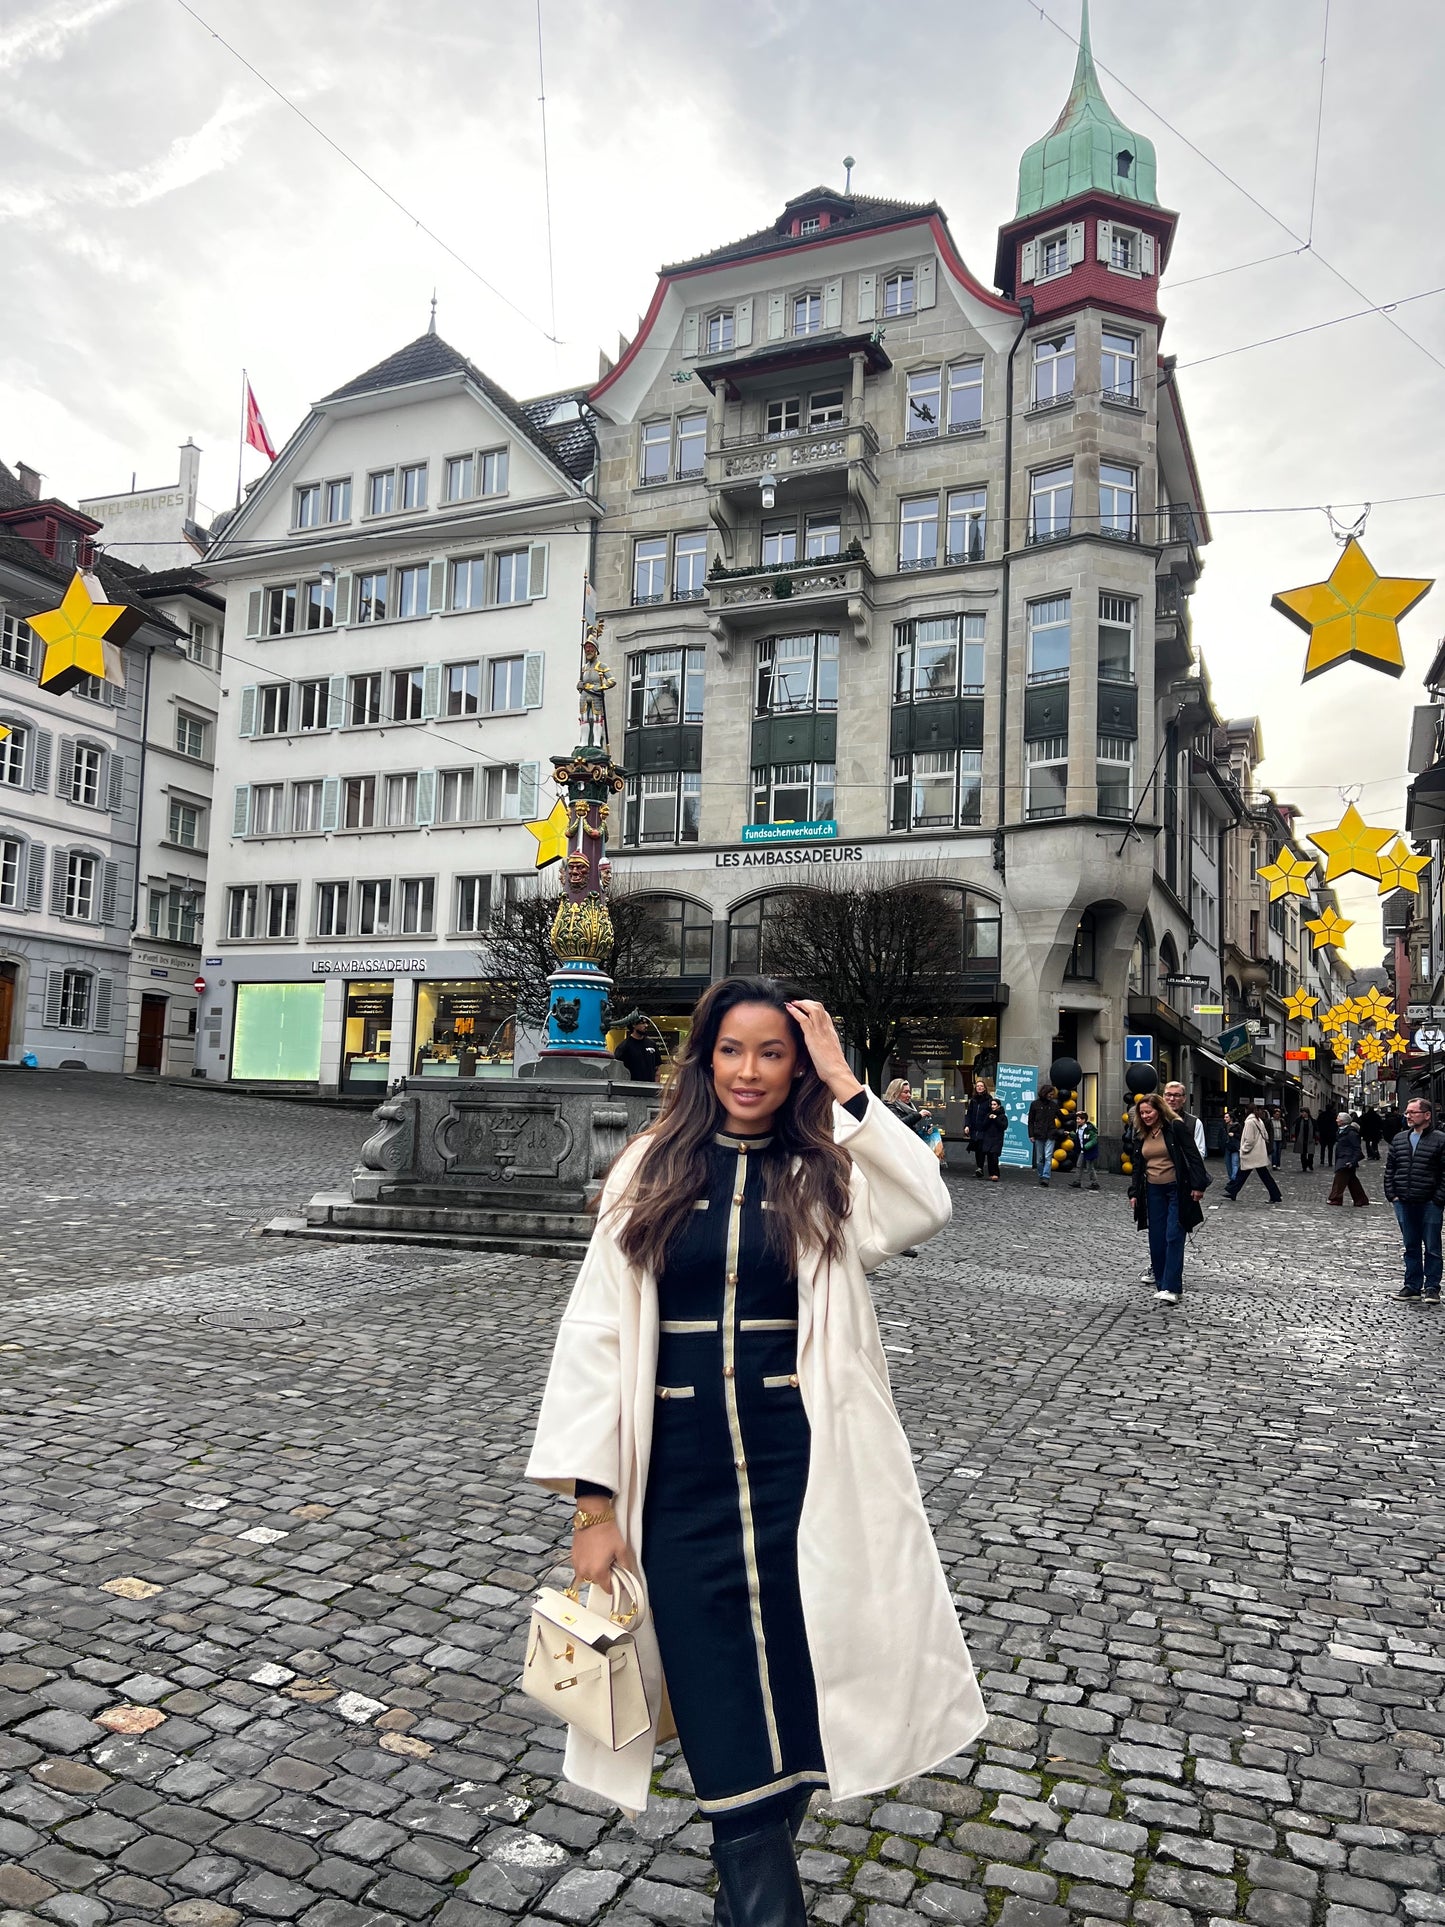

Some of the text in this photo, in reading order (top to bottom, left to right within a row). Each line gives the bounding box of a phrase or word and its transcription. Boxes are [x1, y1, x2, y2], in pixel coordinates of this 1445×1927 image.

[124, 499, 140, 509] DES
[142, 493, 184, 511] ALPES
[745, 825, 833, 840] fundsachenverkauf.ch
[715, 847, 863, 867] LES AMBASSADEURS
[311, 958, 427, 973] LES AMBASSADEURS
[998, 1073, 1033, 1082] Fundgegen-
[999, 1066, 1022, 1074] Verkauf
